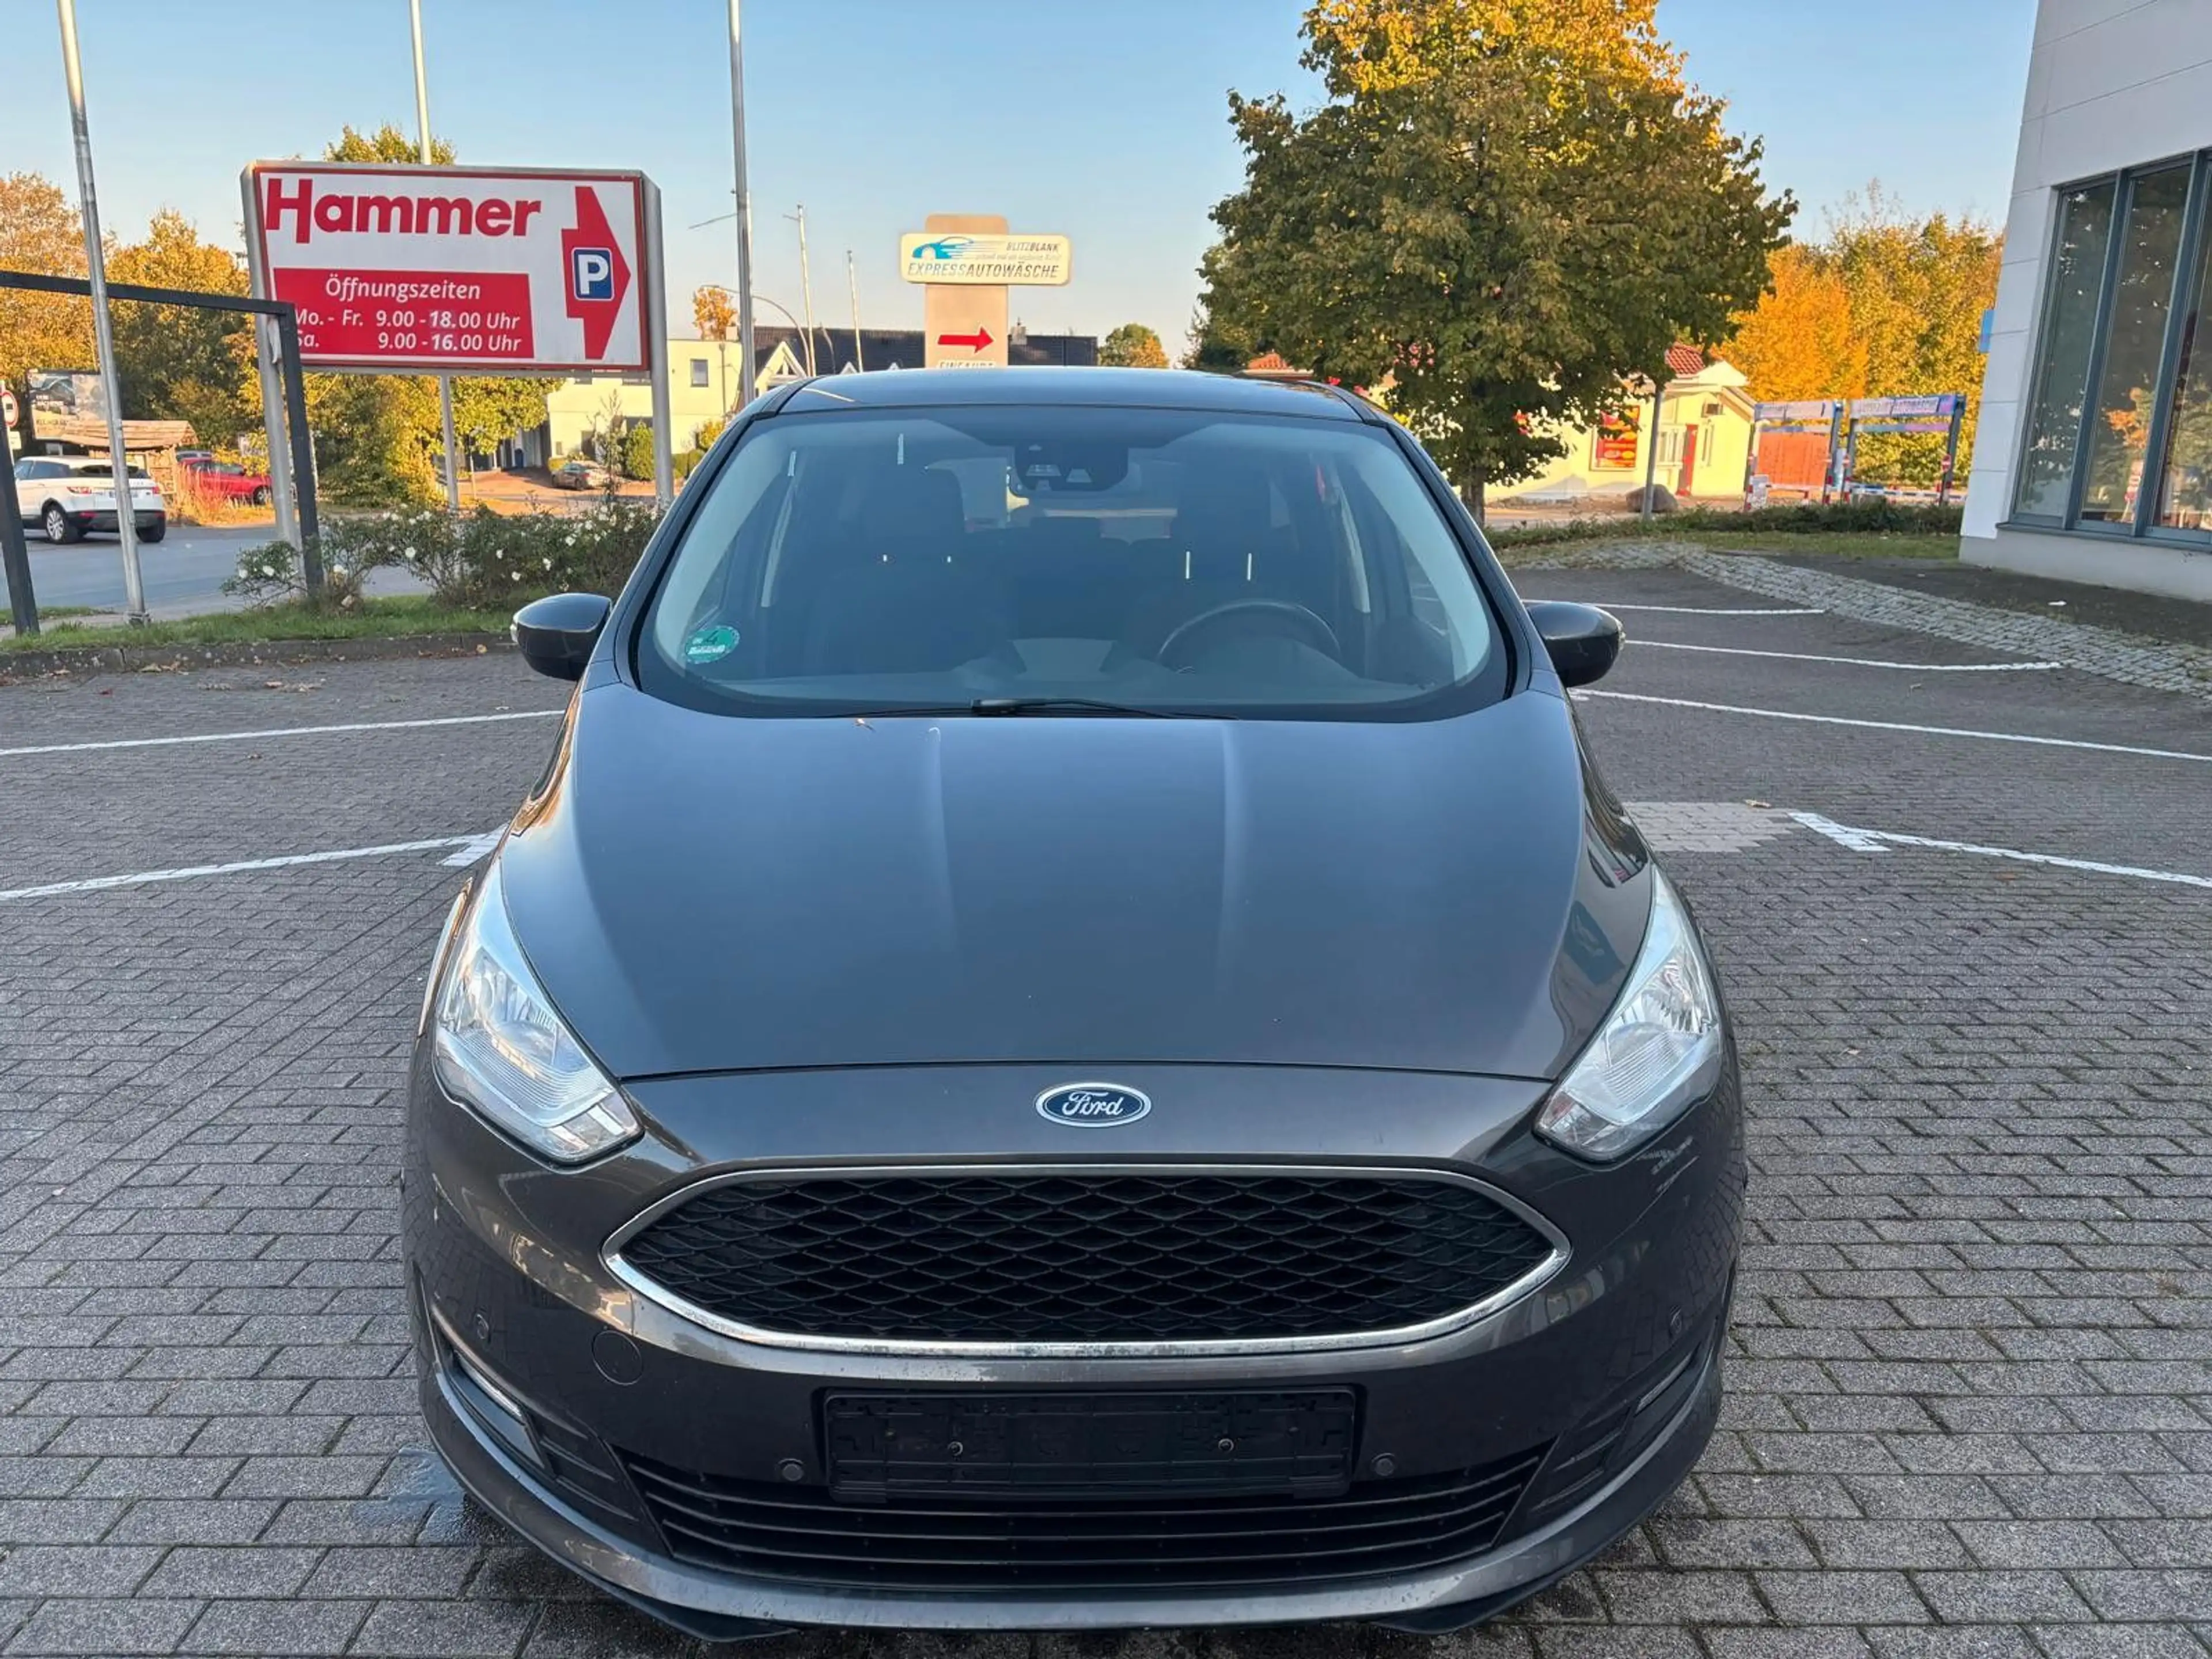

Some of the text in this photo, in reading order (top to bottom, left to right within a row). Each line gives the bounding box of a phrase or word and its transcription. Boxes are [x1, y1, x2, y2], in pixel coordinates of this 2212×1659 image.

[266, 178, 541, 244] Hammer
[1006, 242, 1060, 252] BLITZBLANK
[578, 255, 609, 294] P
[325, 273, 480, 304] Öffnungszeiten
[295, 308, 324, 325] Mo.
[342, 309, 363, 327] Fr.
[376, 310, 415, 327] 9.00
[430, 311, 480, 328] 18.00
[486, 312, 520, 329] Uhr
[378, 332, 416, 349] 9.00
[432, 334, 483, 351] 16.00
[488, 335, 522, 352] Uhr
[706, 630, 719, 645] 4
[1062, 1091, 1124, 1116] Ford
